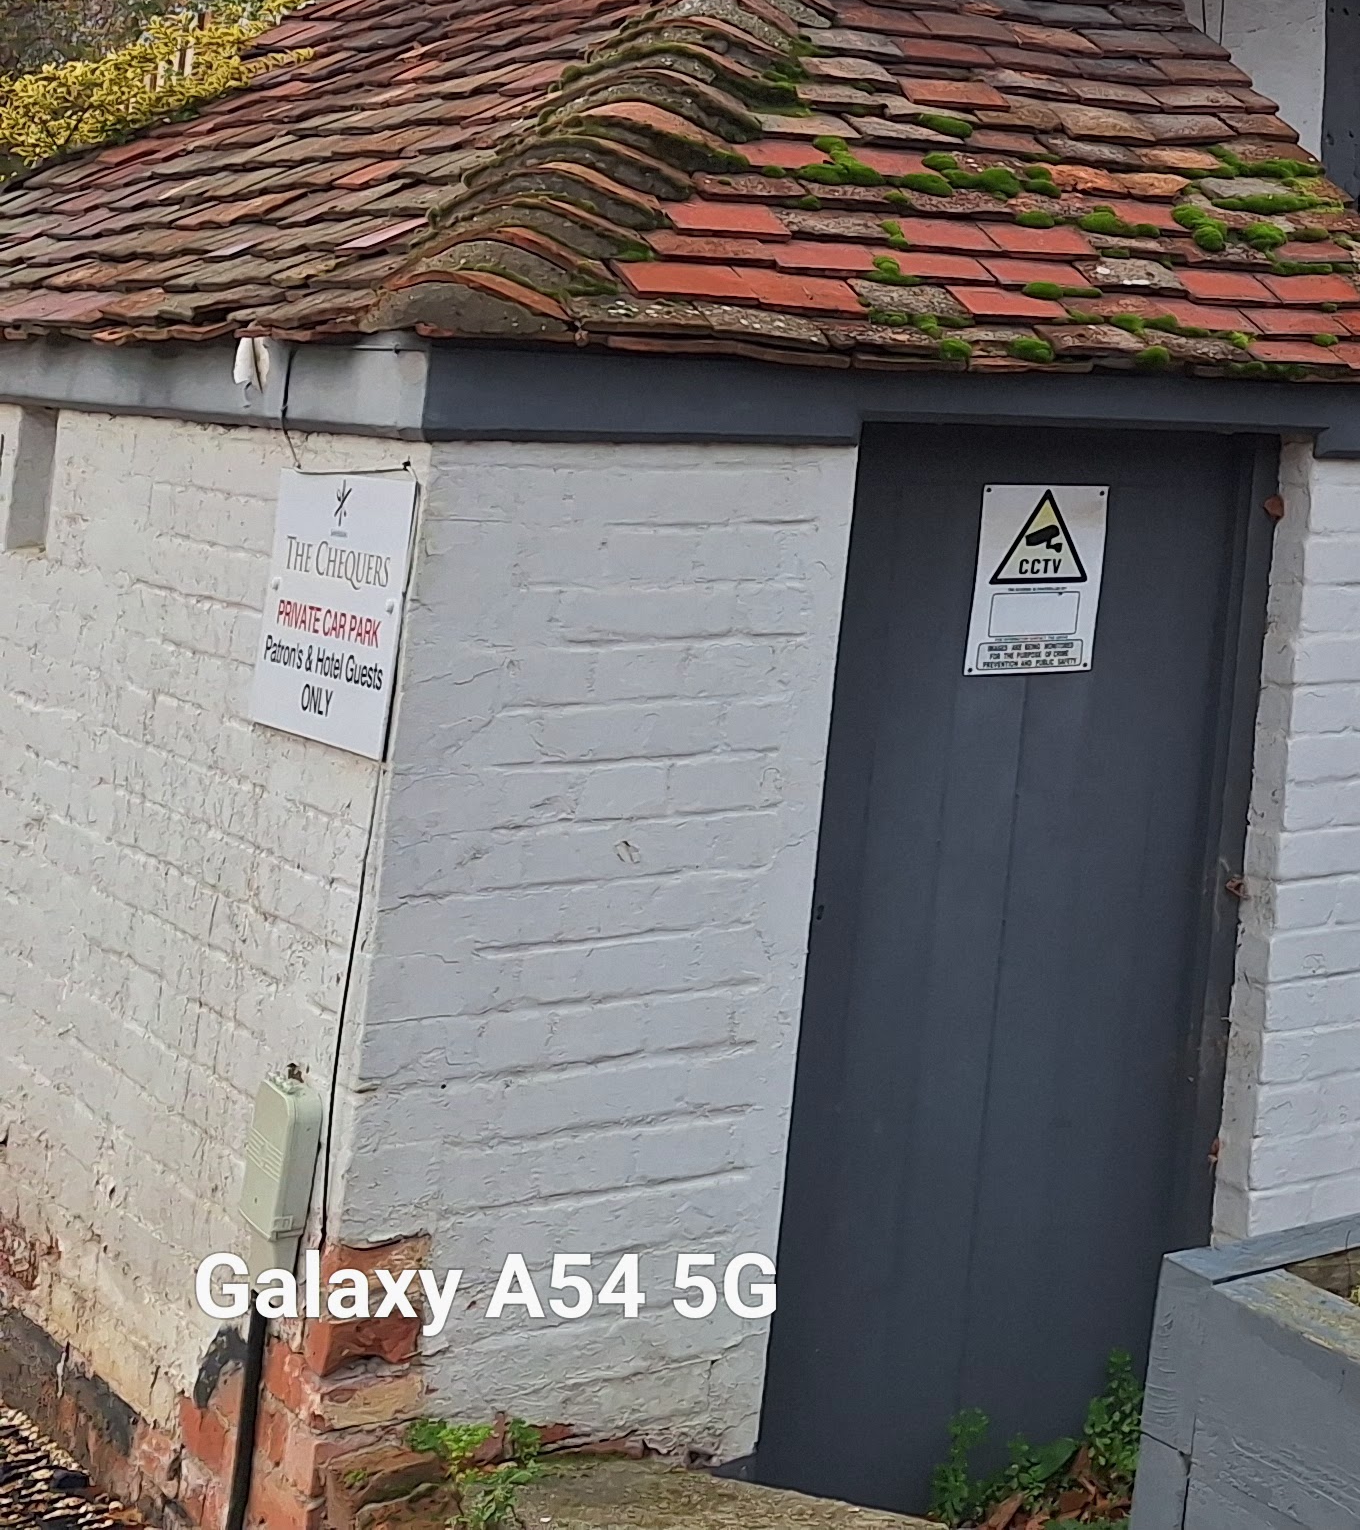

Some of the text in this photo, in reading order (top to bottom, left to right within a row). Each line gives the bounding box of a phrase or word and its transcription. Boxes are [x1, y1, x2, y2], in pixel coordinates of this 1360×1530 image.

[286, 535, 391, 590] THE CHEQUERS
[1018, 558, 1062, 575] CCTV
[277, 599, 382, 649] PRIVATE CAR PARK
[264, 634, 384, 691] Patron's & Hotel Guests
[301, 683, 334, 718] ONLY
